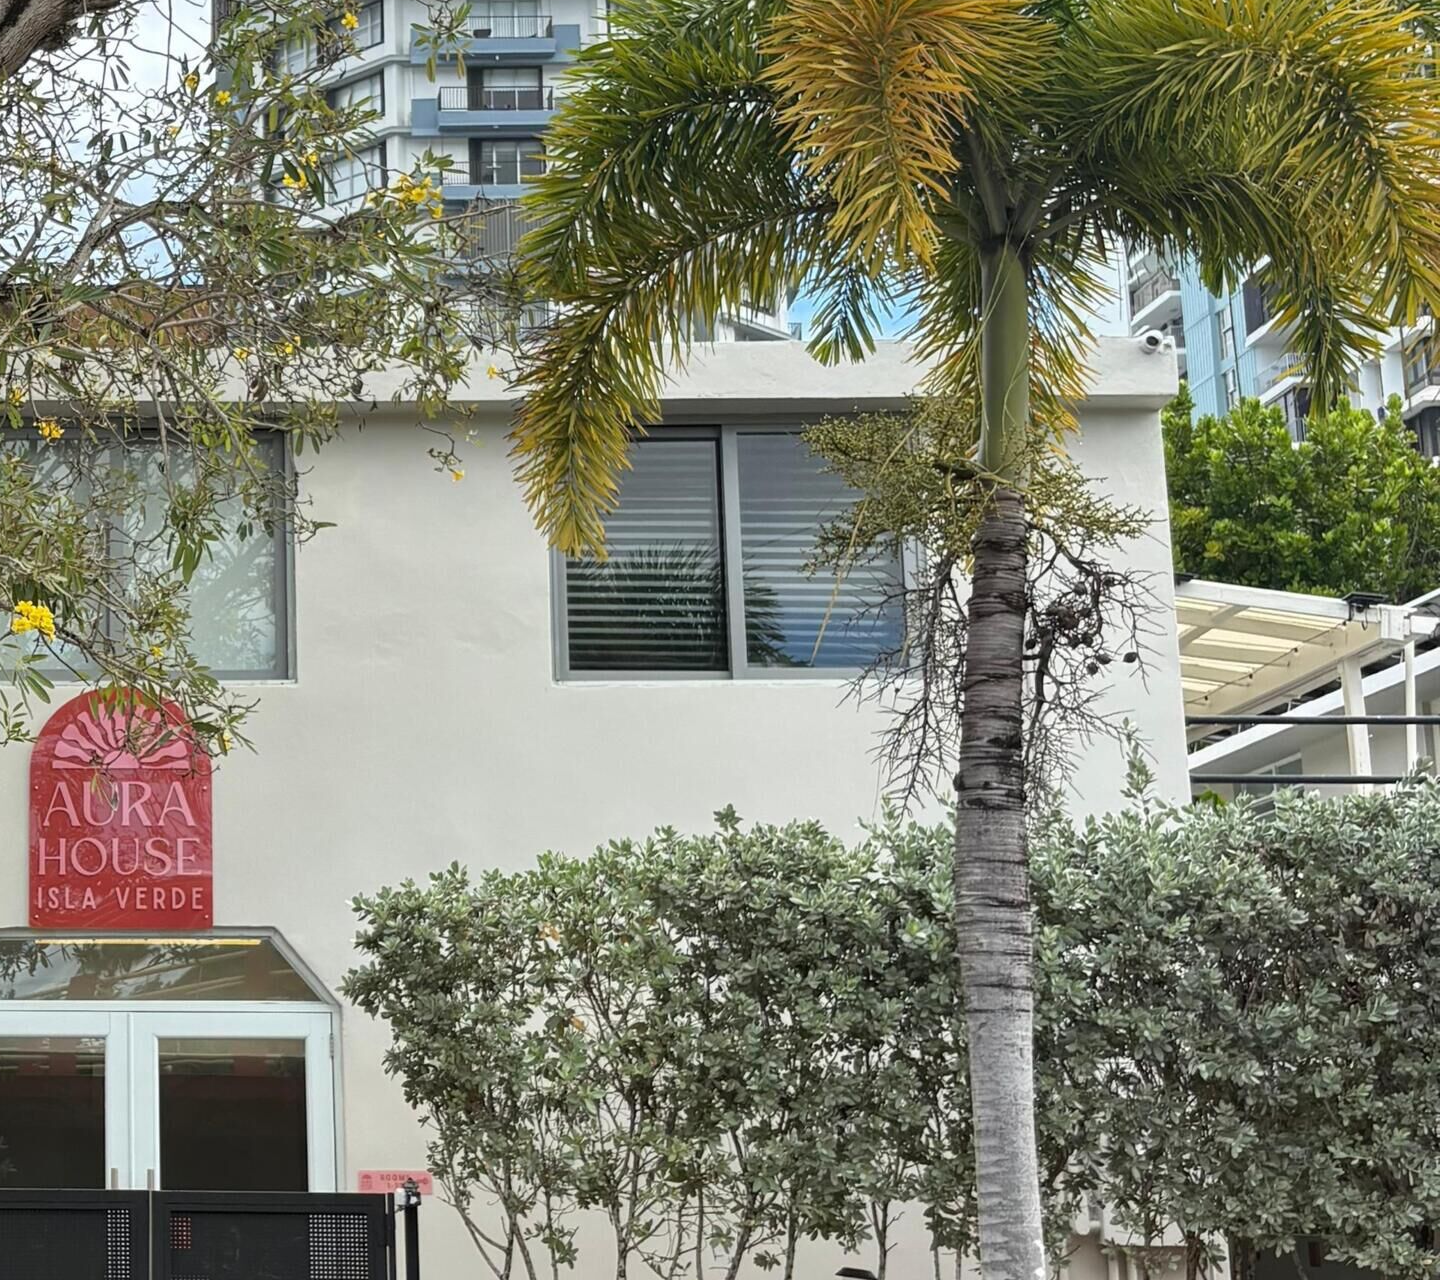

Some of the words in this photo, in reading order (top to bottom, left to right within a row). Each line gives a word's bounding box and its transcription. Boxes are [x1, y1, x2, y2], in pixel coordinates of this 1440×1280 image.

[42, 781, 197, 827] AURA
[38, 838, 202, 876] HOUSE
[38, 887, 97, 910] ISLA
[116, 887, 205, 910] VERDE
